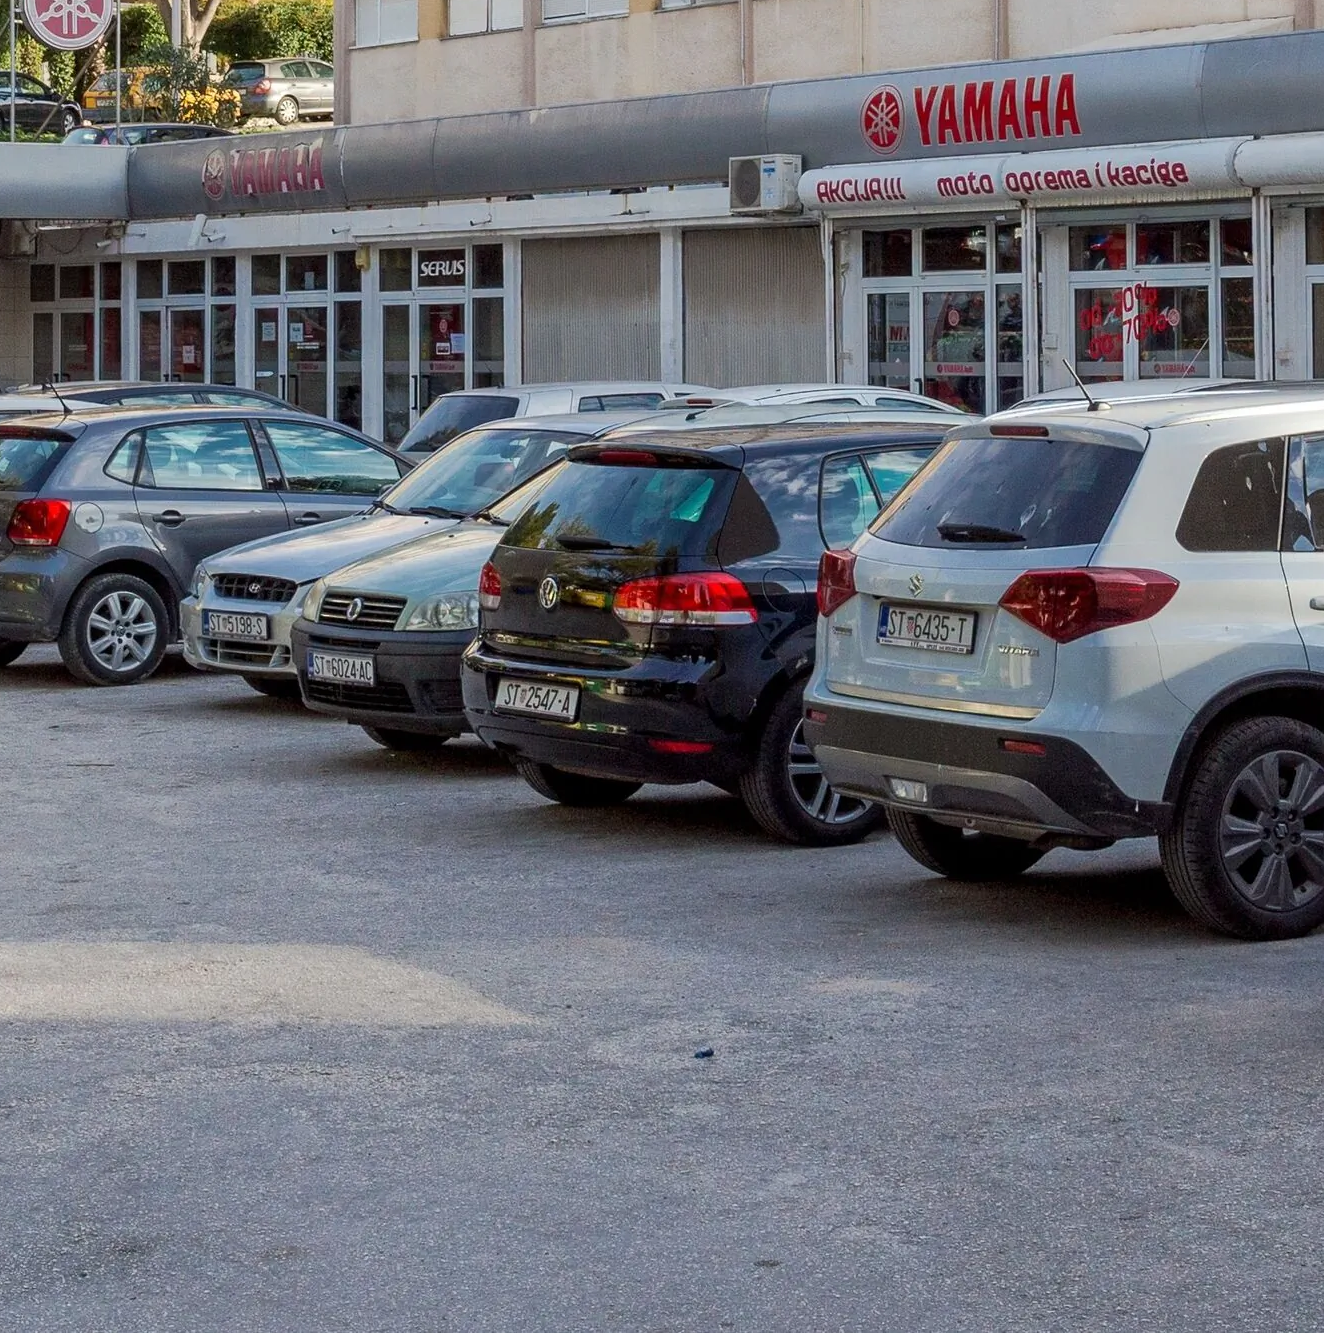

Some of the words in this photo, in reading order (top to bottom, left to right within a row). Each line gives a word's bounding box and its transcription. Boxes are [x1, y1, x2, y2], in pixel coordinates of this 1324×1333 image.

[913, 72, 1082, 146] YAMAHA
[229, 138, 325, 198] YAMAHA
[816, 177, 907, 203] AKCIJA!!!
[936, 171, 994, 197] moto
[1005, 169, 1091, 201] oprema
[1094, 162, 1104, 188] i
[1106, 158, 1190, 188] kacige
[420, 259, 465, 277] SERVIS
[210, 614, 222, 632] ST
[888, 610, 907, 635] ST
[913, 612, 967, 643] 6435-T
[314, 655, 325, 675] ST
[504, 683, 521, 706] ST
